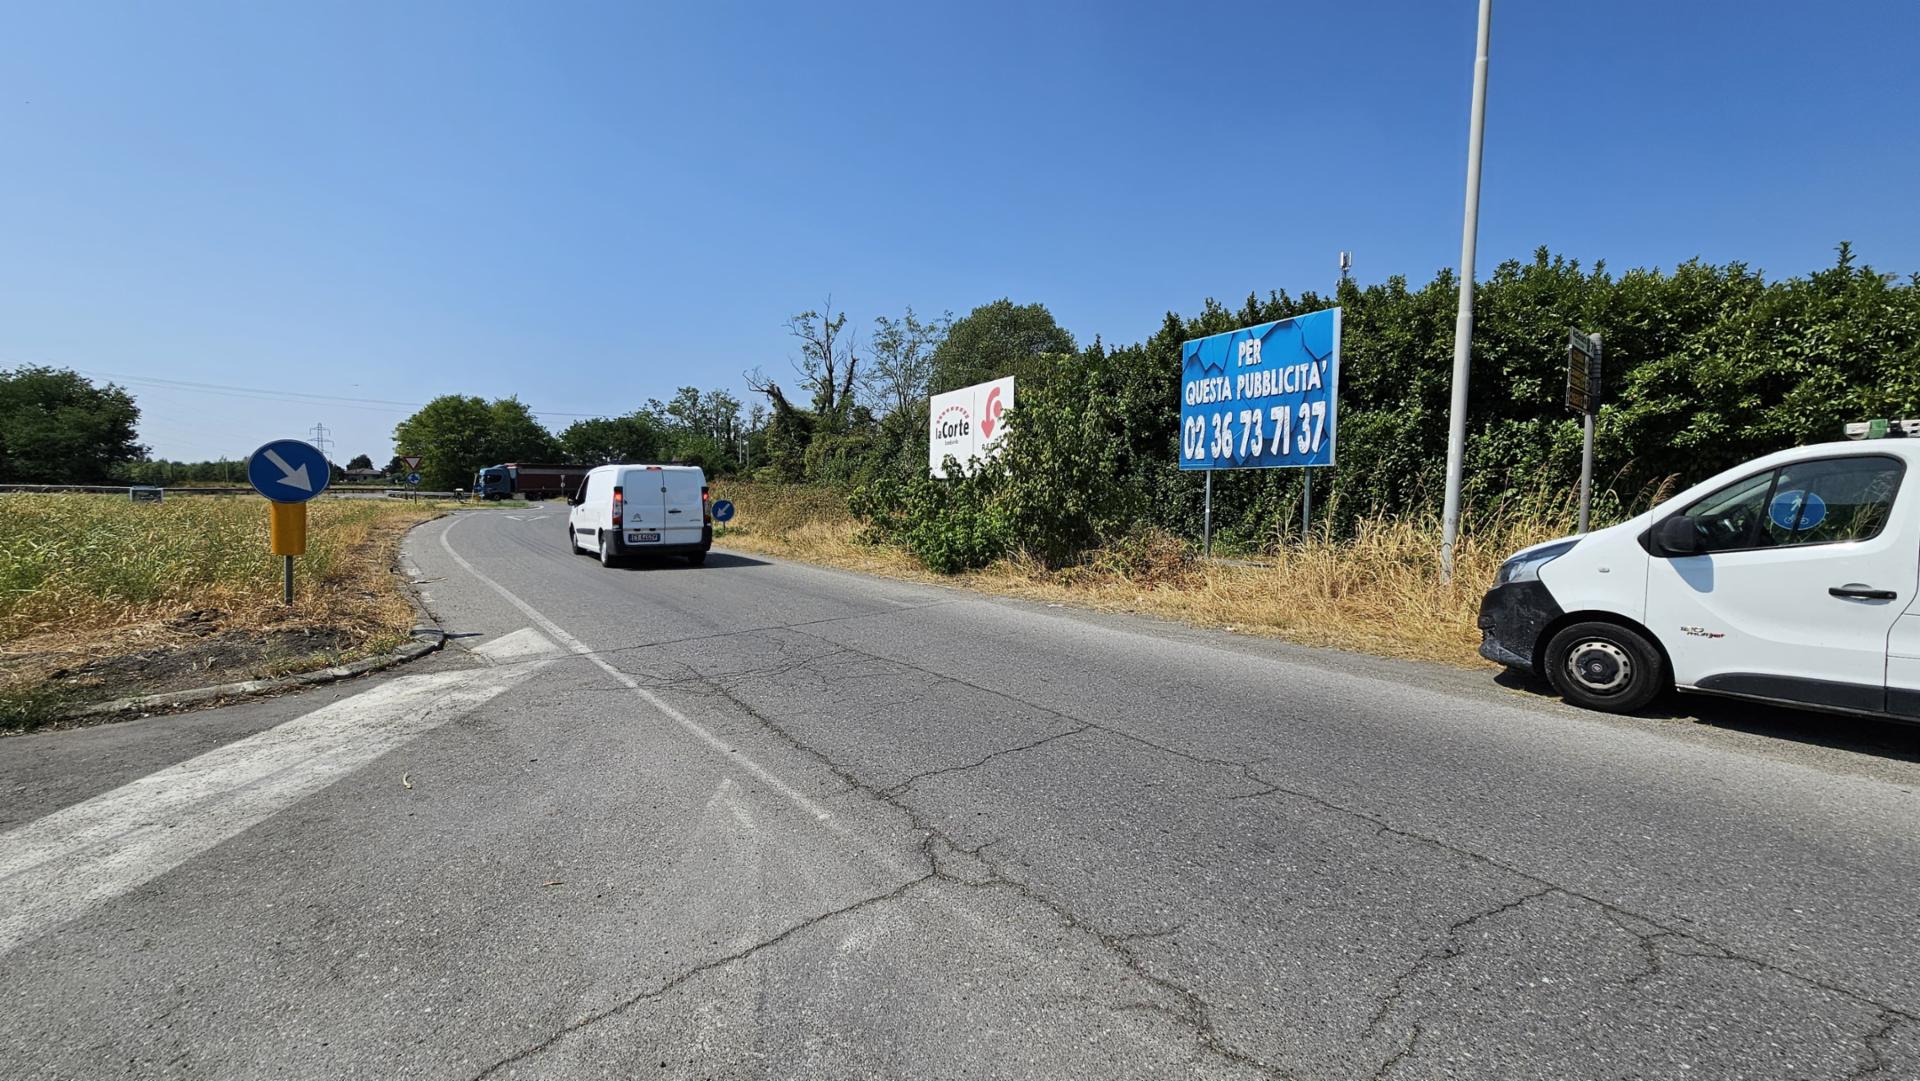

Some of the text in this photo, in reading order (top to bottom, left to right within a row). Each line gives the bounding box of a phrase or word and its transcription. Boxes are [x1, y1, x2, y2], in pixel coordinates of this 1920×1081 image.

[1238, 338, 1262, 367] PER
[1185, 376, 1232, 407] QUESTA
[1184, 401, 1326, 460] 02 36 73 71 37
